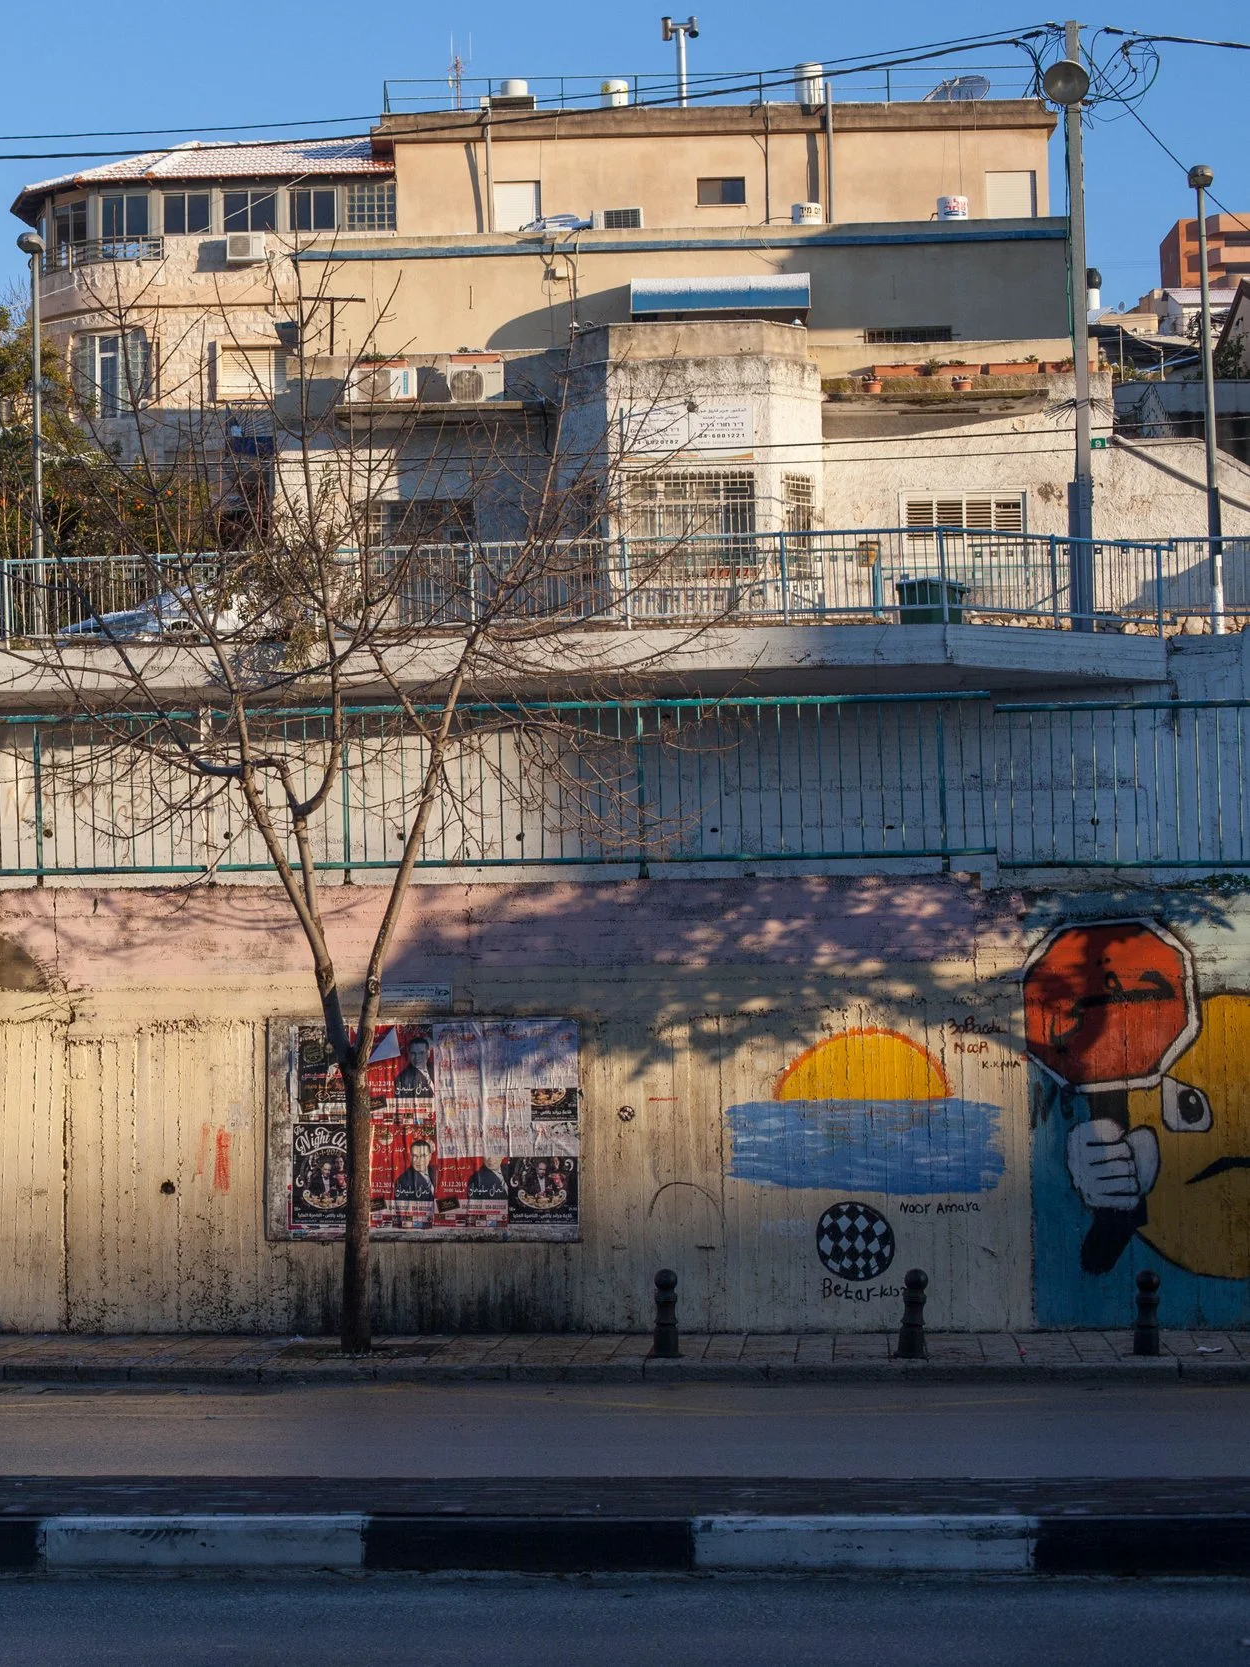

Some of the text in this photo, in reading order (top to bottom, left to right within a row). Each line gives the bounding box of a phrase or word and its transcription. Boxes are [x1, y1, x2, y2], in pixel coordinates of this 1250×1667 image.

[1095, 440, 1102, 448] 9
[295, 1127, 331, 1155] Night
[900, 1201, 981, 1215] Noor Amara
